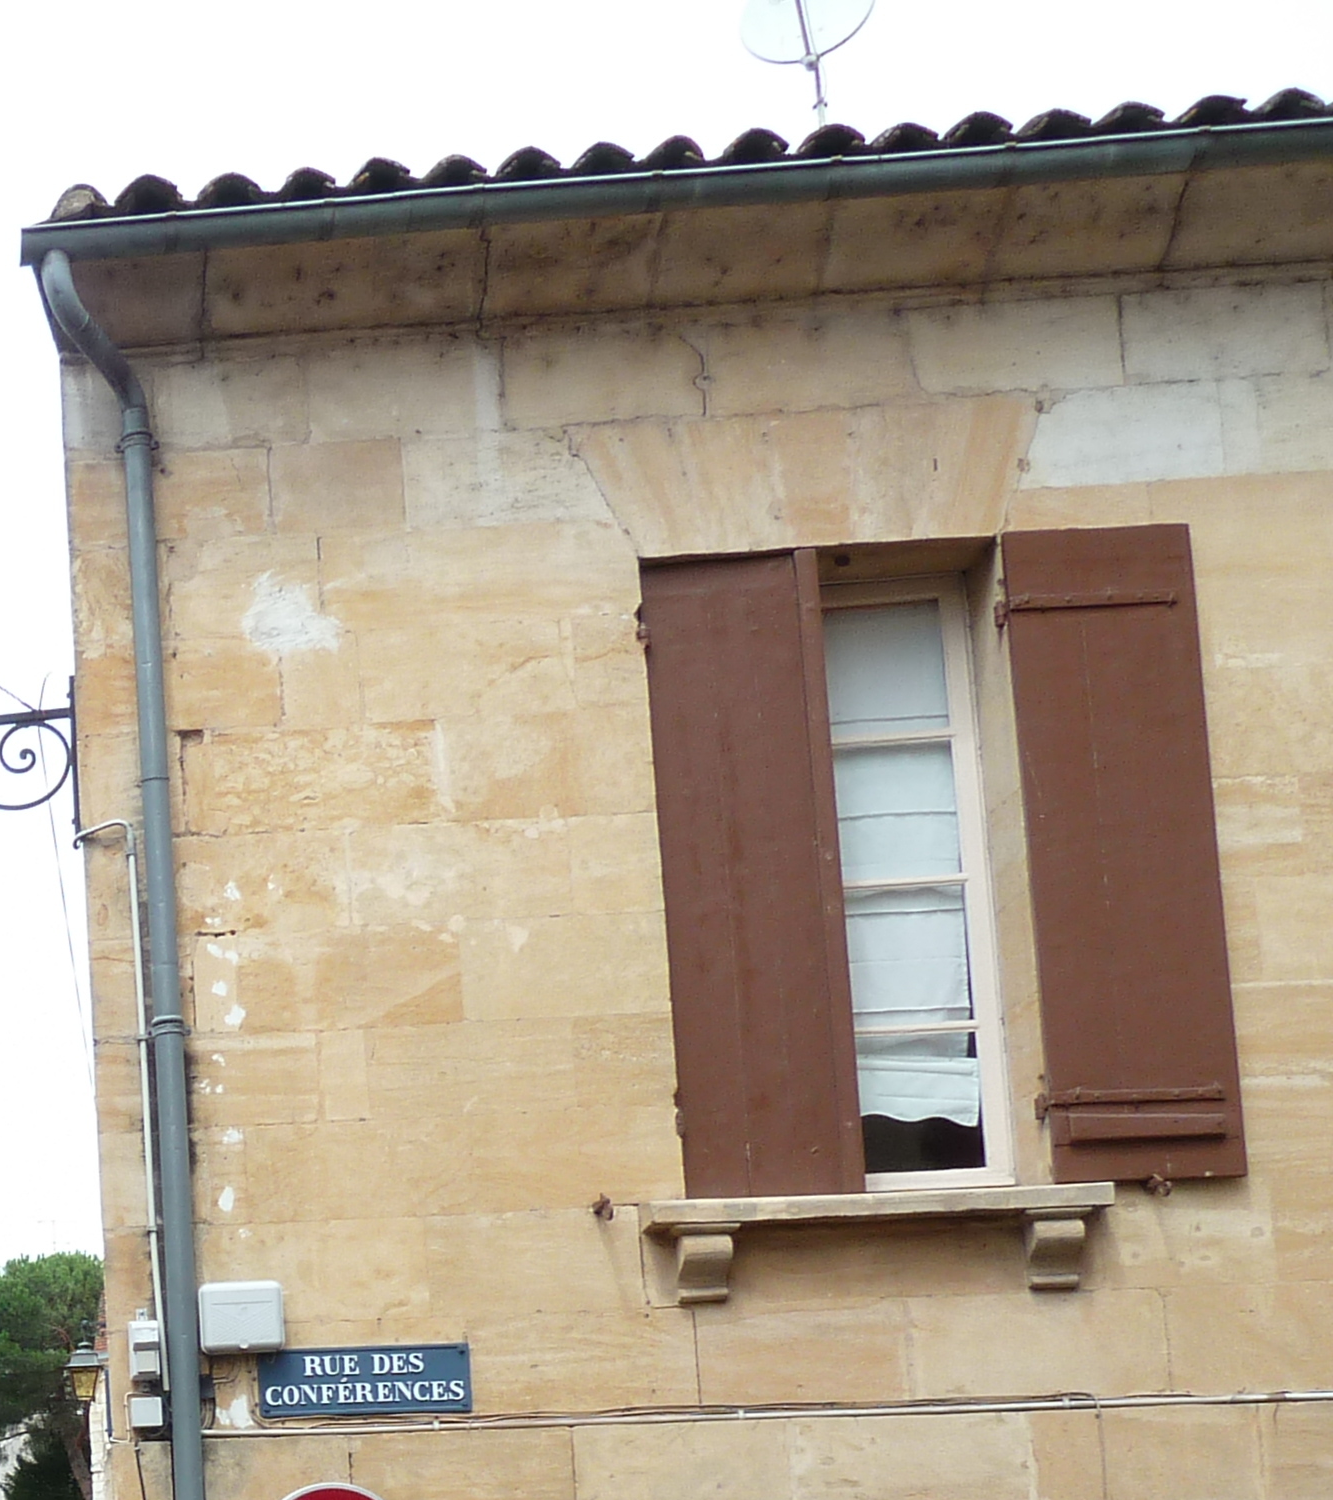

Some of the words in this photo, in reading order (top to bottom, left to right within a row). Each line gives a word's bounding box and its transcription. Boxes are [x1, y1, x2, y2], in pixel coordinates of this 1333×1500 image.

[302, 1354, 361, 1377] RUE
[371, 1352, 425, 1376] DES
[264, 1376, 466, 1407] CONFÉRENCES
